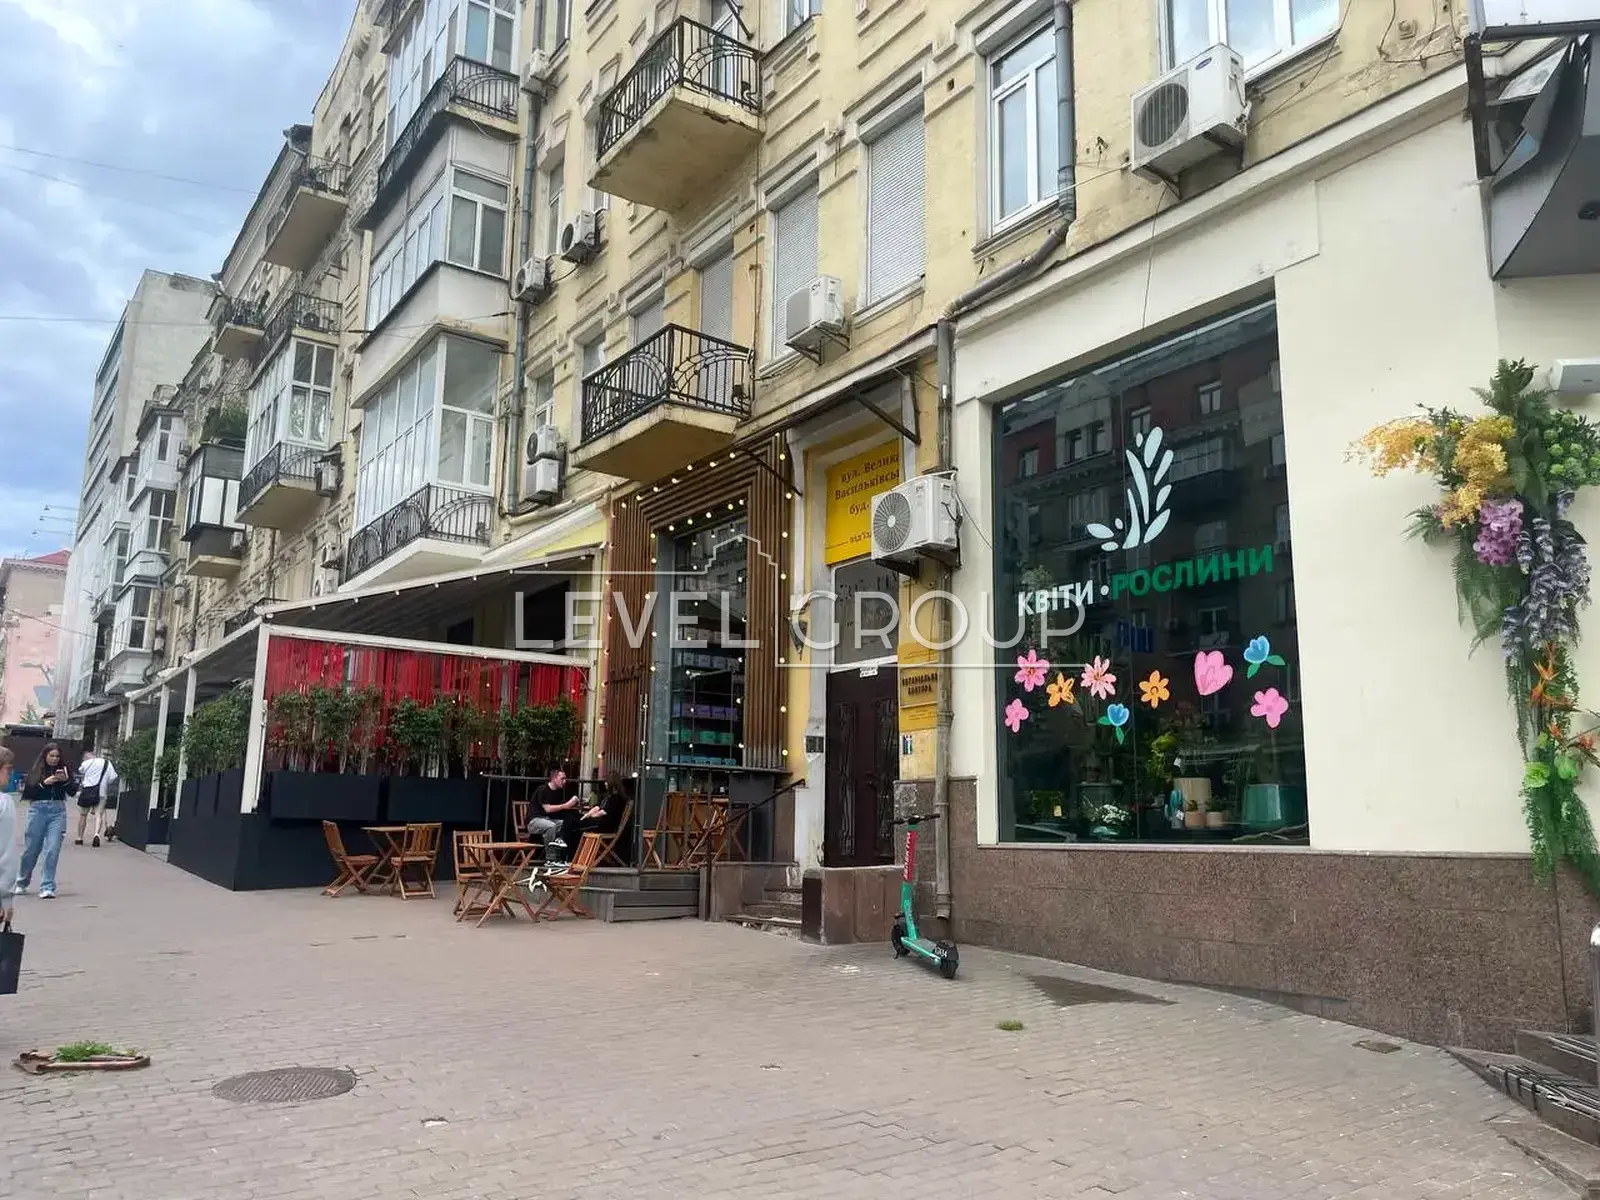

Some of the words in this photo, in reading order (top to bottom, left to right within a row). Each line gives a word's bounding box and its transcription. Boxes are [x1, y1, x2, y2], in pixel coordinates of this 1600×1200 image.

[841, 469, 861, 484] вул.
[1018, 580, 1094, 617] КВІТИ
[1111, 544, 1274, 600] РОСЛИНИ
